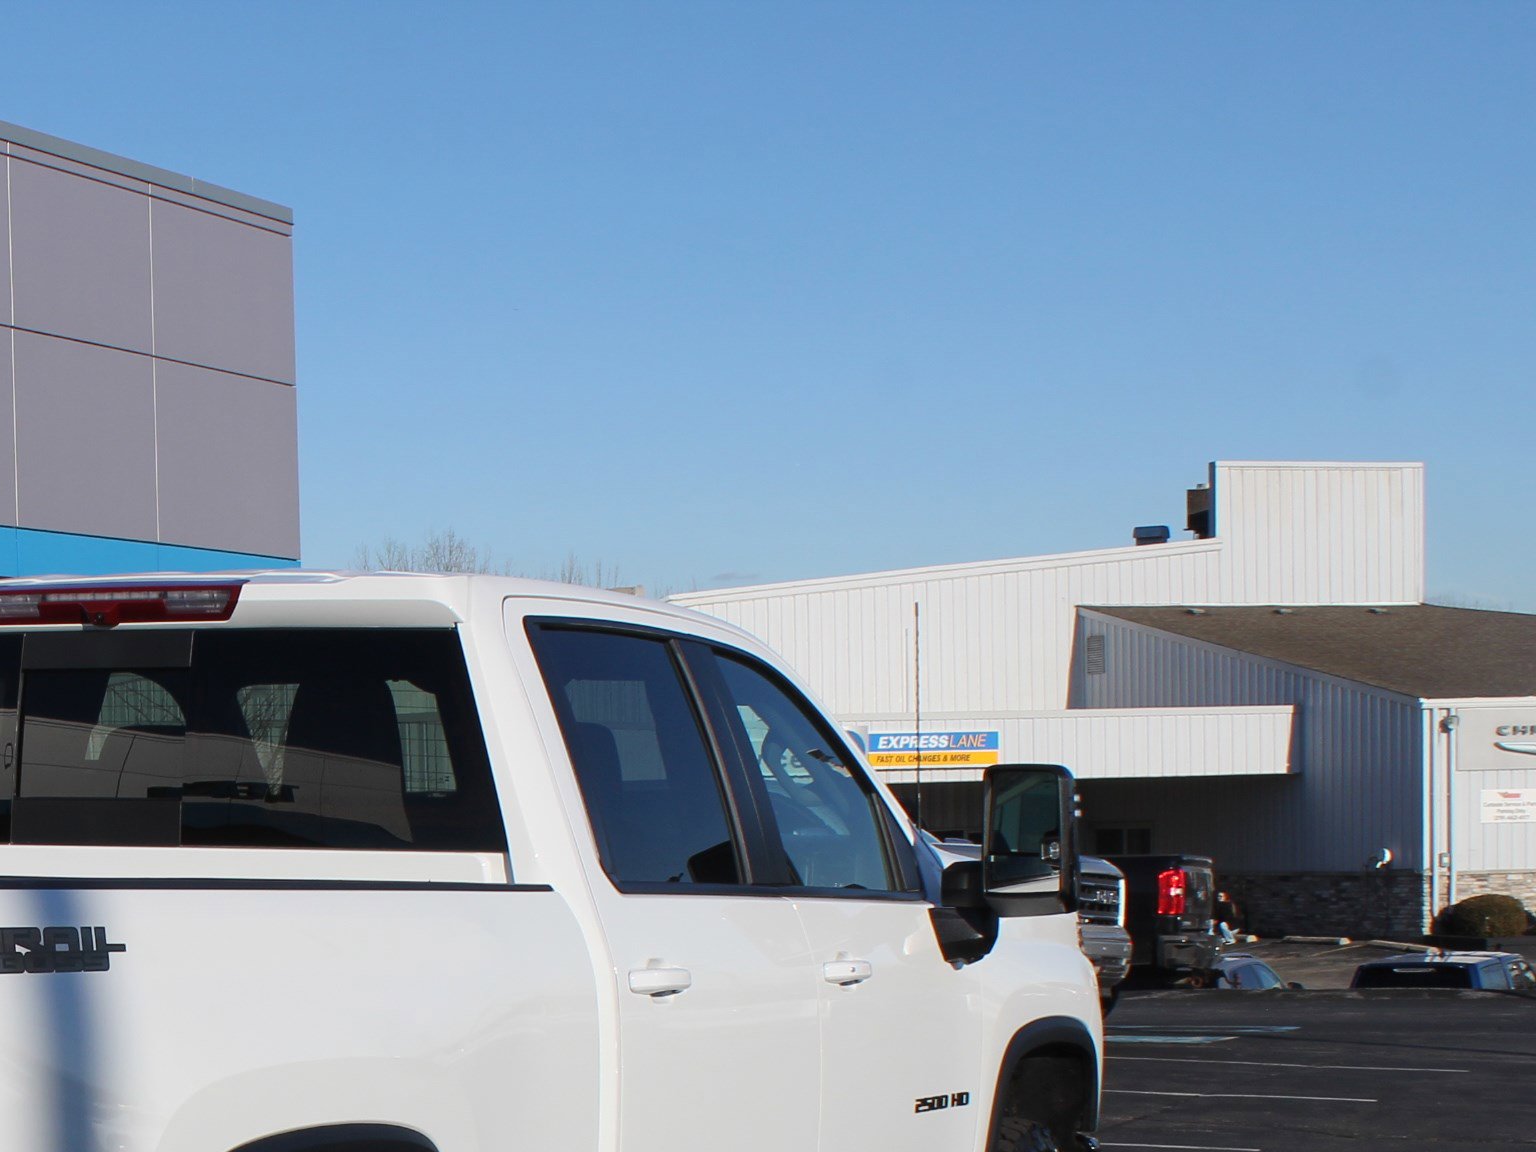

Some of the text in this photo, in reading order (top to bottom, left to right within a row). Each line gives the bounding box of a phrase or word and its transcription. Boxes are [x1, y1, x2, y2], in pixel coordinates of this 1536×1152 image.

[876, 755, 893, 763] FAST
[895, 755, 906, 763] OIL
[943, 754, 948, 762] &
[950, 754, 970, 762] MORE
[914, 1091, 970, 1113] 2500 HD
